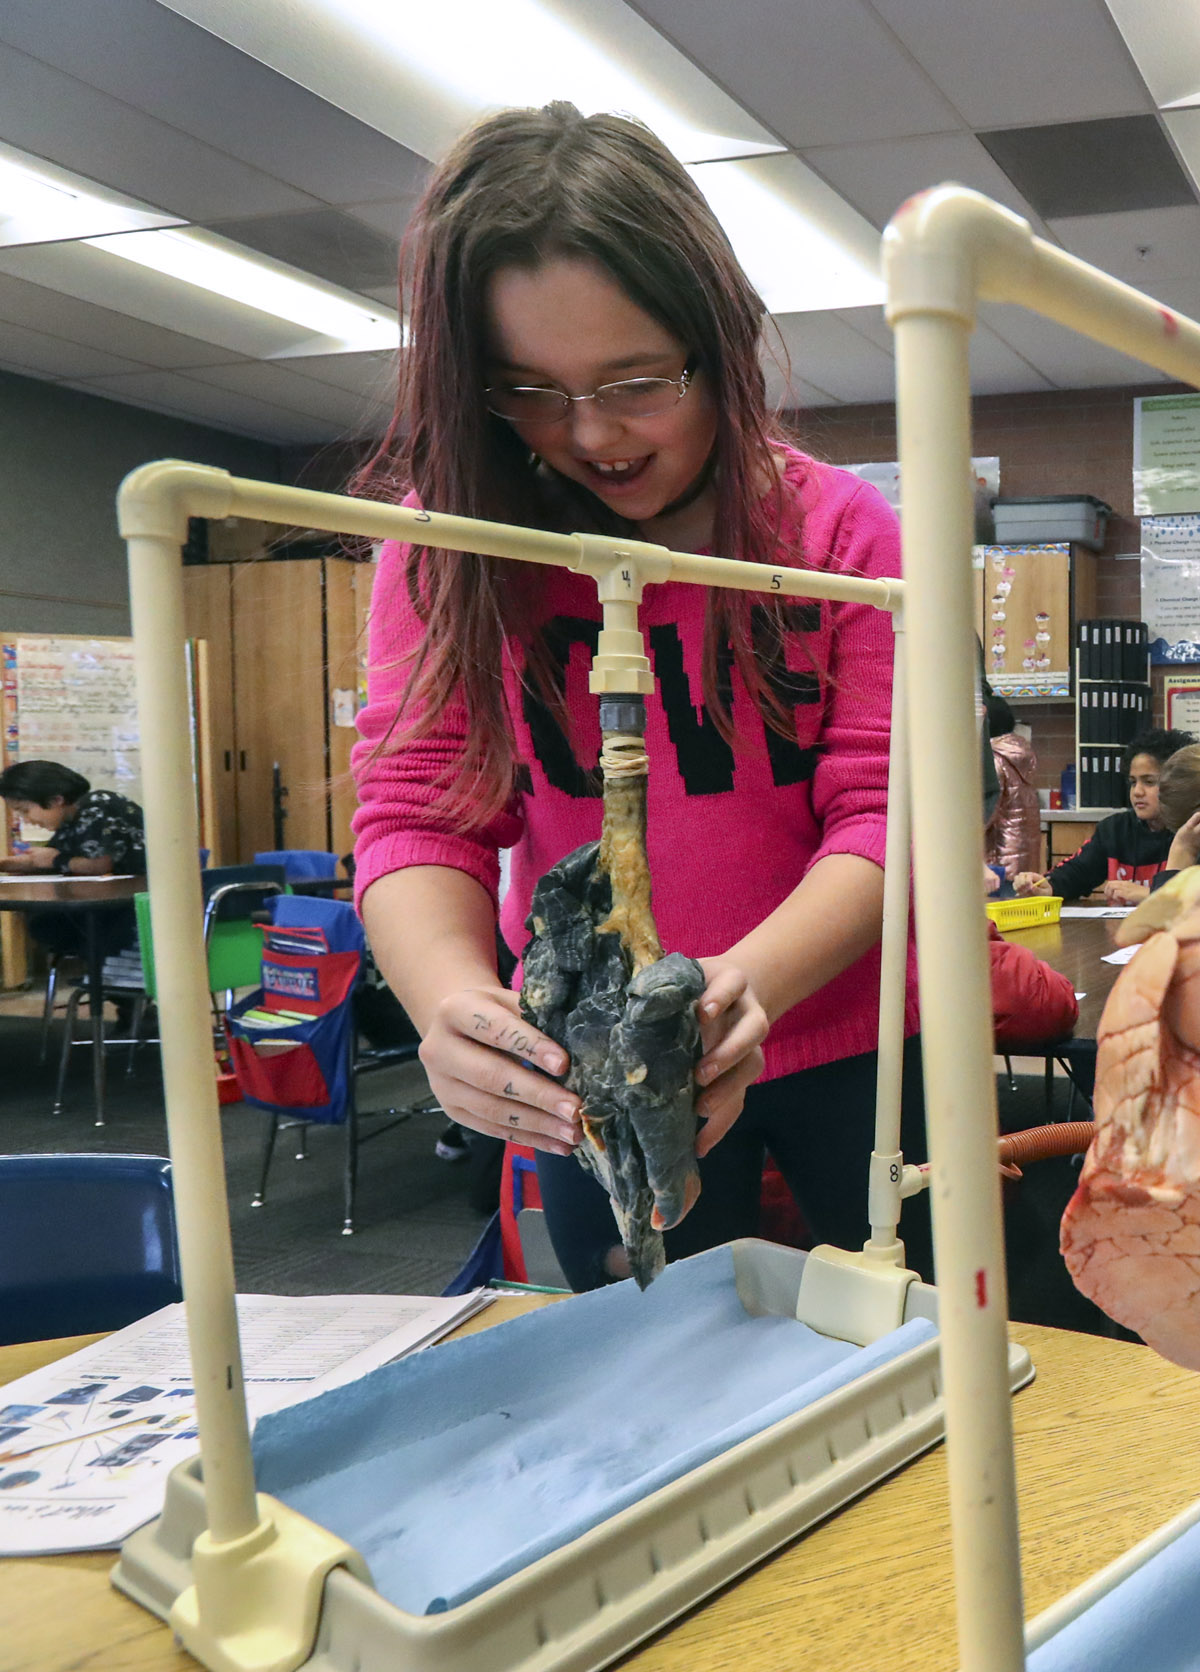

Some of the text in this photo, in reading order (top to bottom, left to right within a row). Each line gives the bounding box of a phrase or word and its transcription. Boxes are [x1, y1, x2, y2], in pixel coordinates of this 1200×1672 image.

[770, 574, 783, 590] 5
[513, 603, 824, 798] OVE
[889, 1164, 899, 1182] 8
